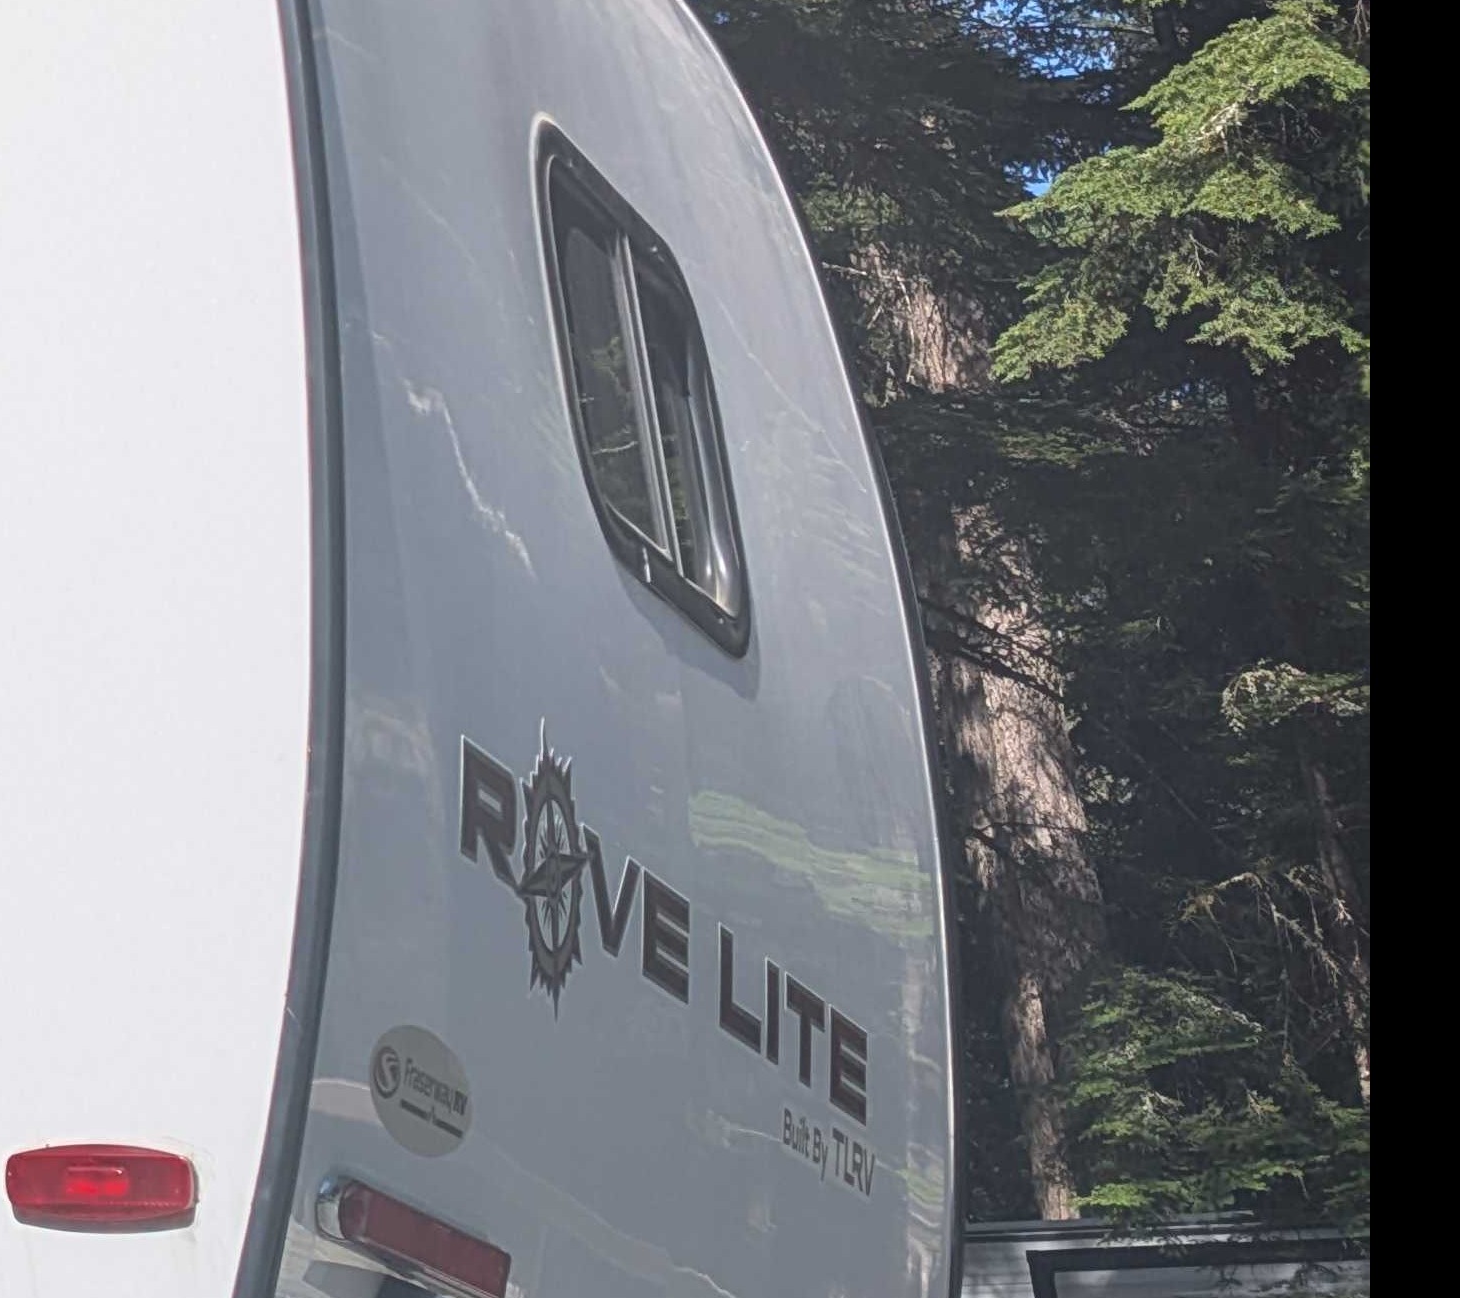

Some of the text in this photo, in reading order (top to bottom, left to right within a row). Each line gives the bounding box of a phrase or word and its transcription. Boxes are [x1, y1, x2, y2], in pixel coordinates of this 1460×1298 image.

[718, 921, 868, 1126] LITE
[783, 1107, 876, 1196] Built By TLRV
